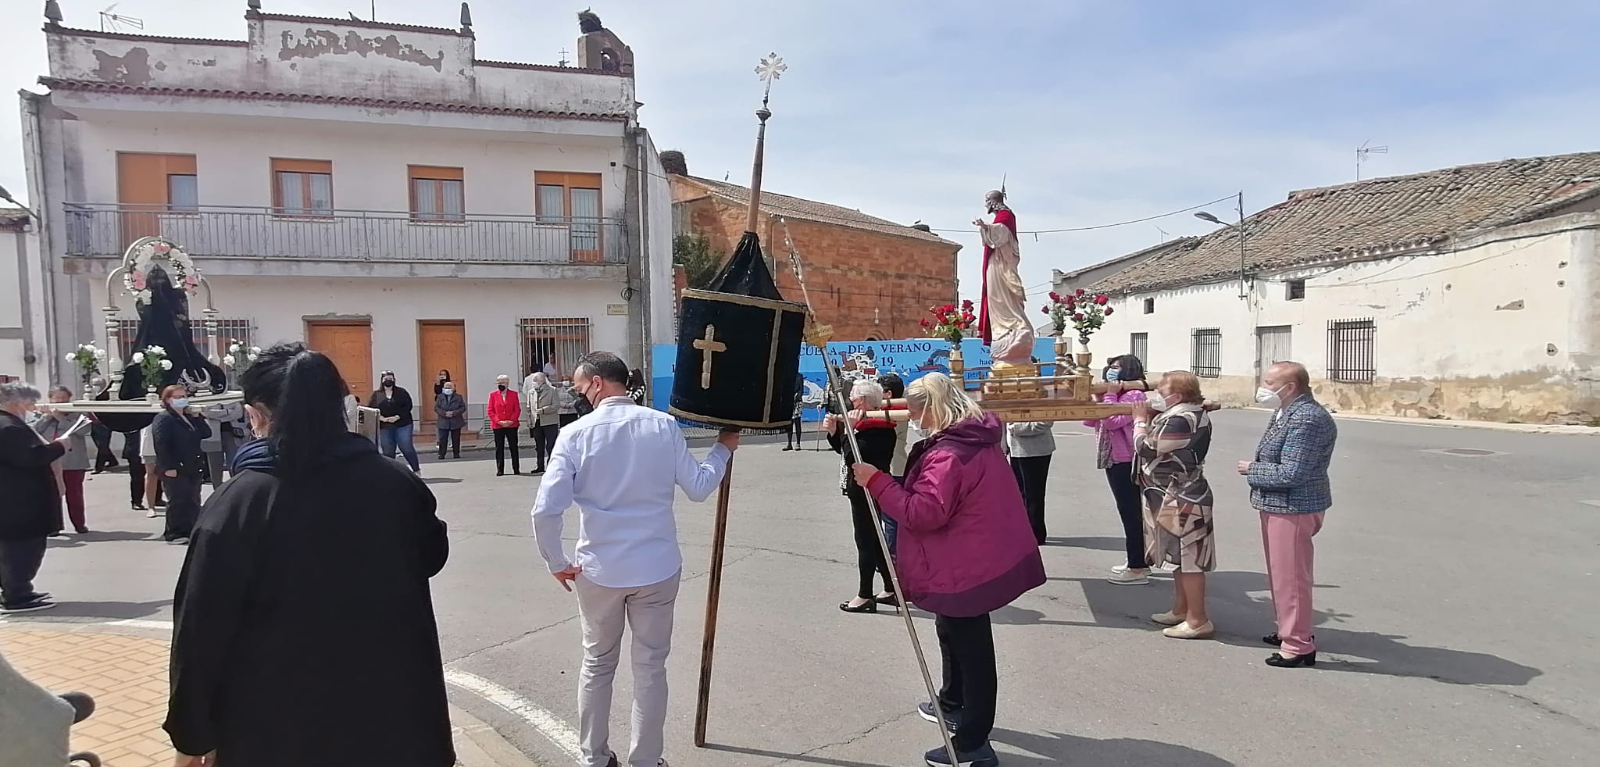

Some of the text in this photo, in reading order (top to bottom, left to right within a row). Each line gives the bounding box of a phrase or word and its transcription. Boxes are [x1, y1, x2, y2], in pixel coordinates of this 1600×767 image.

[847, 344, 865, 355] DE
[880, 342, 932, 354] VERANO
[881, 356, 894, 367] 19
